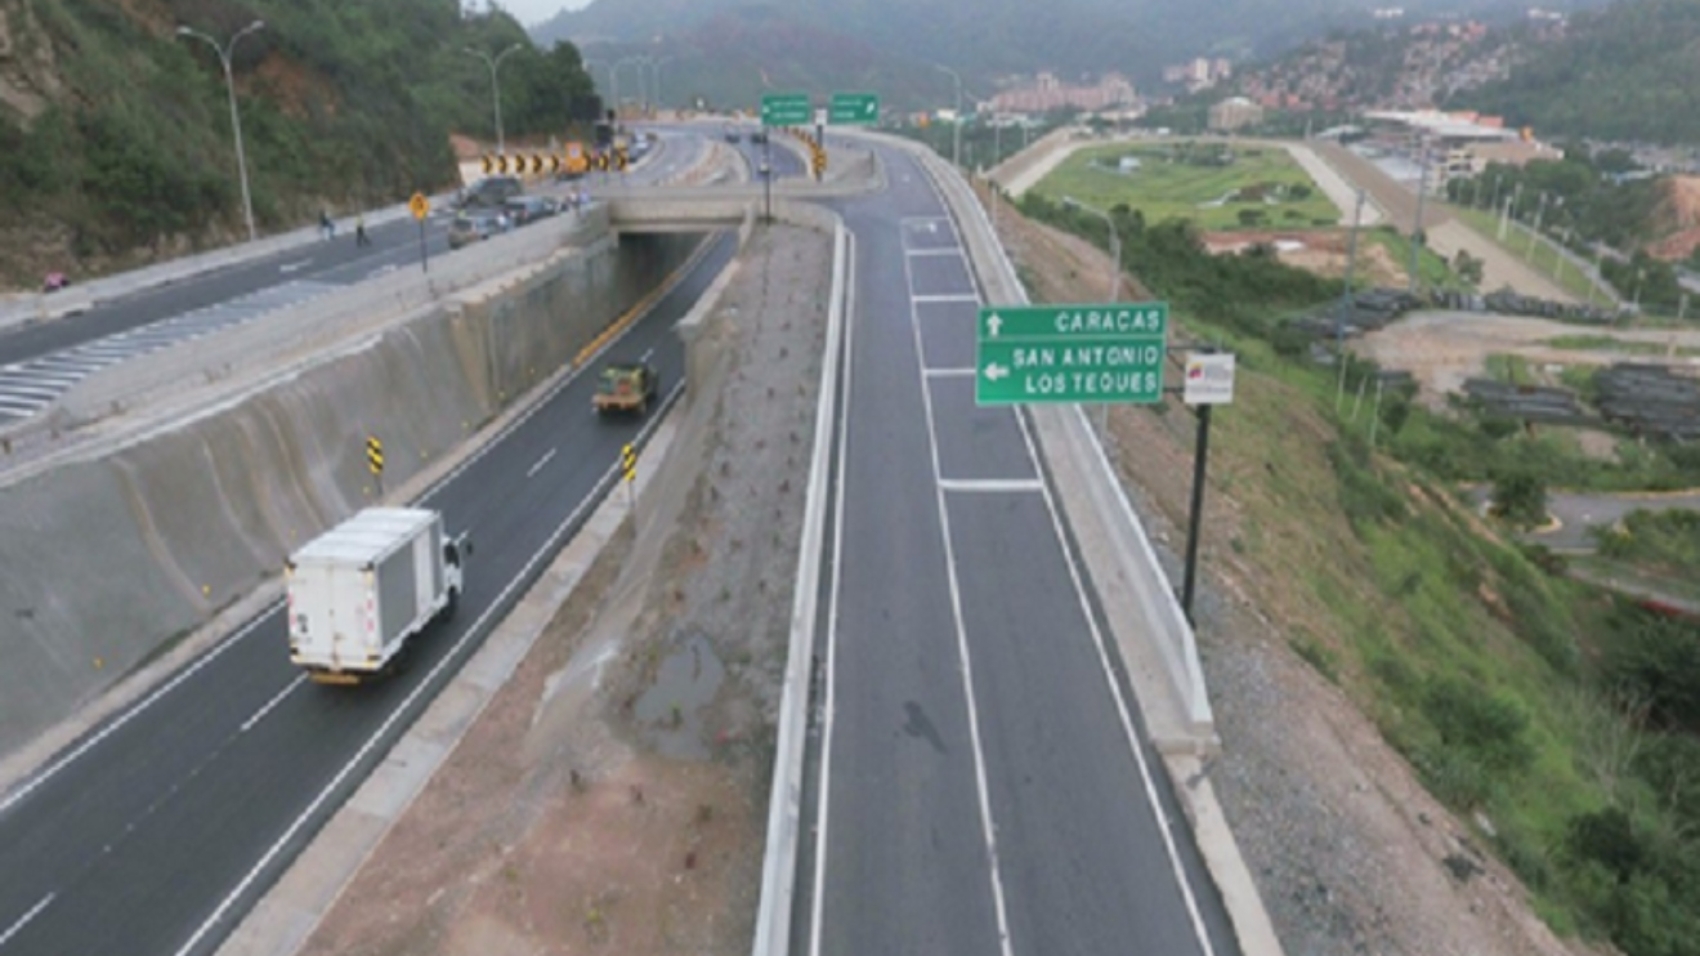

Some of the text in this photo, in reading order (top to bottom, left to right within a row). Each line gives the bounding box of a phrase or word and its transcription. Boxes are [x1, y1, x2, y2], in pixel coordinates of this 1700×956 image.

[1054, 310, 1160, 333] CARACAS
[1013, 346, 1159, 369] SAN ANTONIO
[1025, 373, 1157, 394] LOS TEQUES
